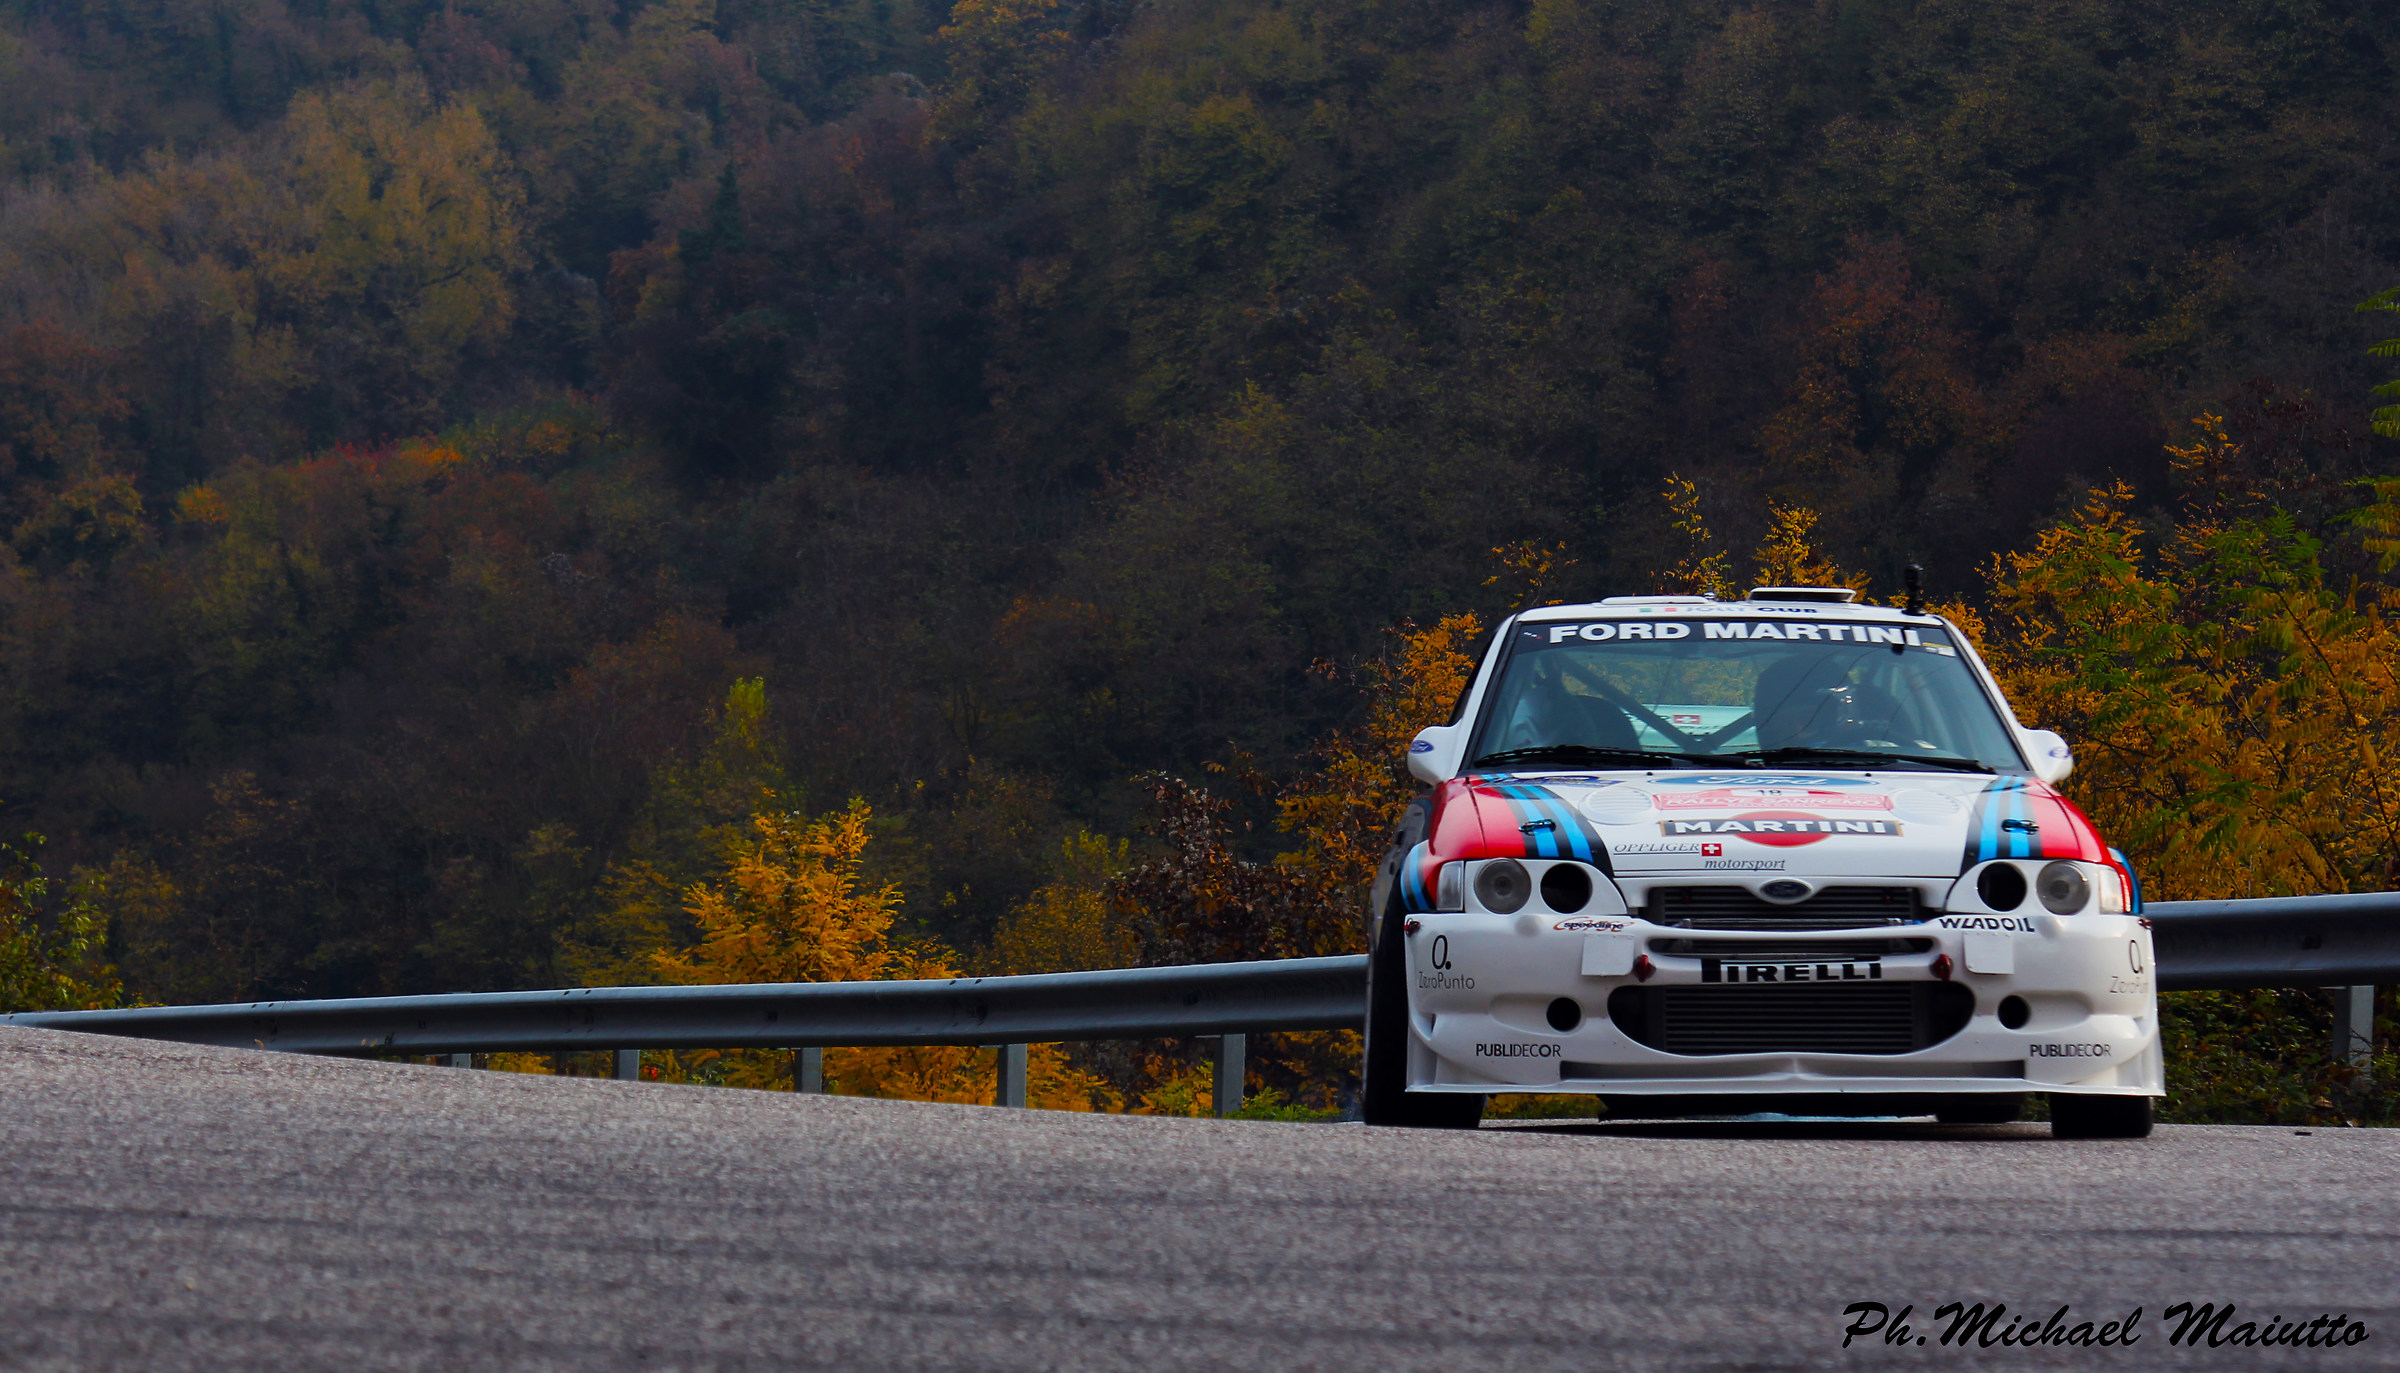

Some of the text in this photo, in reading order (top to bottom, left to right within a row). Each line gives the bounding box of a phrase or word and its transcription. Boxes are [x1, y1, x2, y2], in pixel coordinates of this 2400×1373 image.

[1549, 622, 1921, 647] FORD MARTINI
[1697, 775, 1828, 786] Ford
[1674, 820, 1888, 834] MARTINI
[1614, 842, 1700, 853] OPPLIGER
[1704, 858, 1786, 872] motorsport
[1939, 917, 2035, 933] WLADOIL
[1701, 957, 1882, 983] PIRELLI
[1418, 971, 1475, 990] ZeroPunto
[1475, 1043, 1562, 1058] PUBLIDECOR
[2030, 1043, 2112, 1058] PUBLIDECOR
